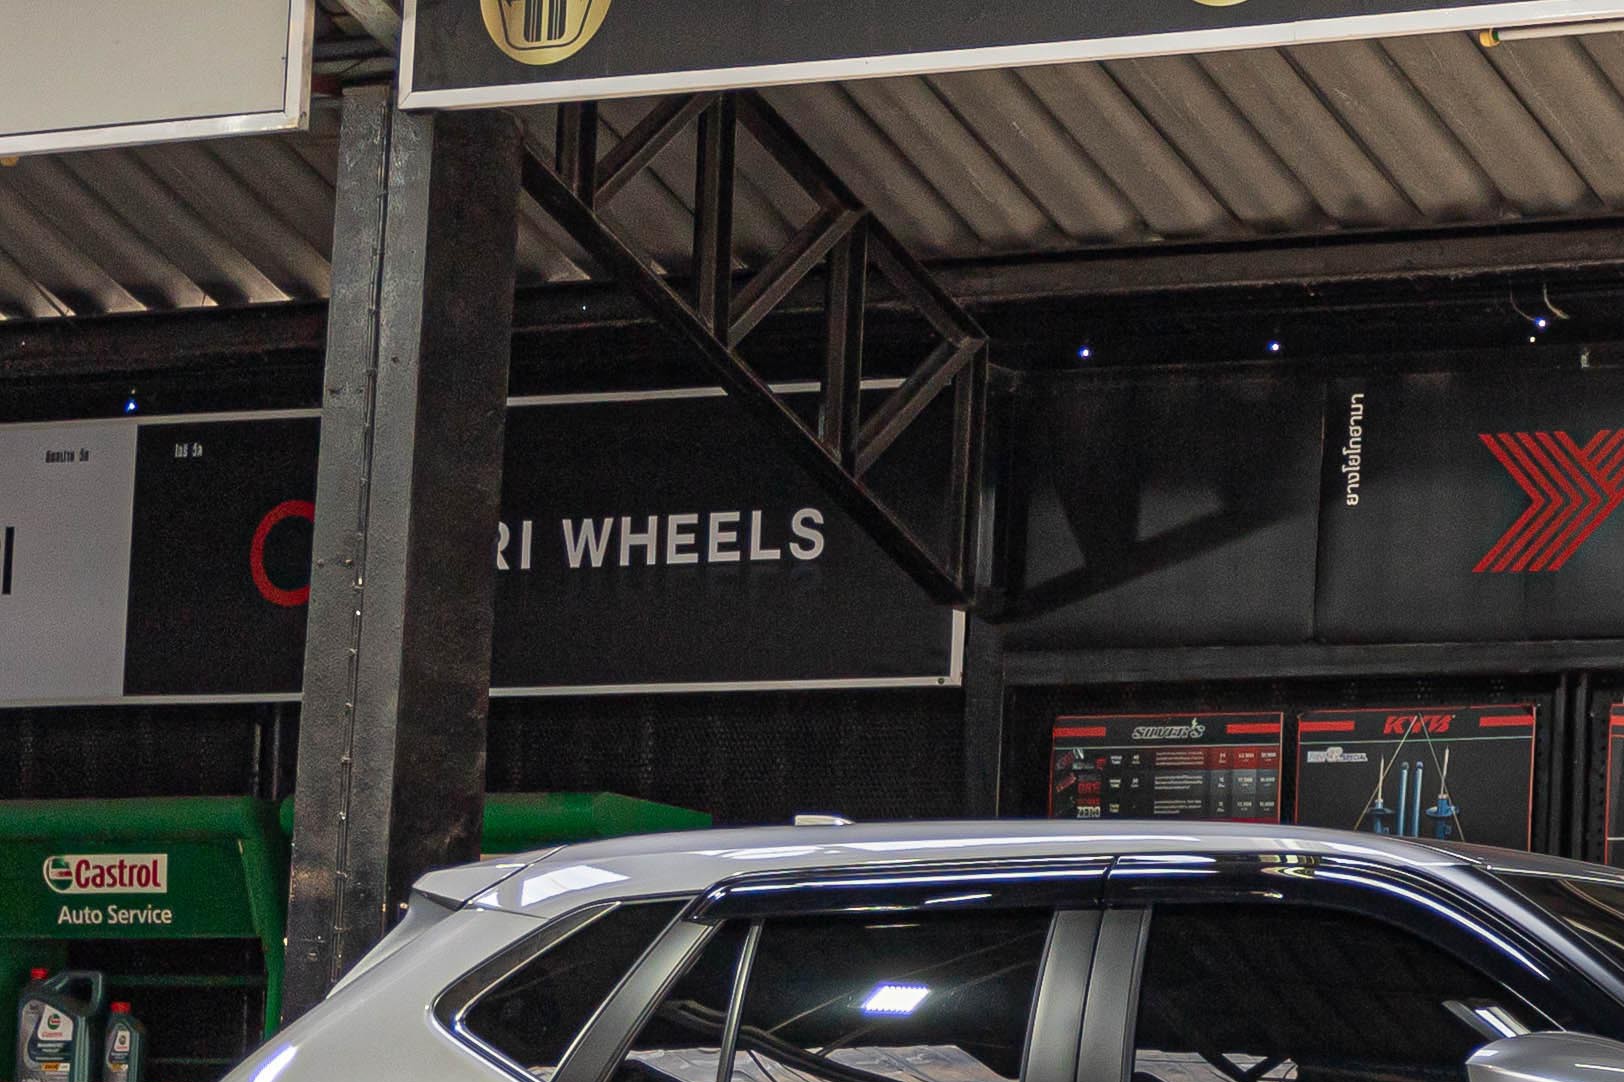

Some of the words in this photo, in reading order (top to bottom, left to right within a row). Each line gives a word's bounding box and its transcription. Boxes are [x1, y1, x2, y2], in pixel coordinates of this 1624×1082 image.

[562, 508, 825, 568] WHEELS
[75, 859, 161, 889] Castrol
[58, 905, 102, 924] Auto
[107, 904, 172, 924] Service
